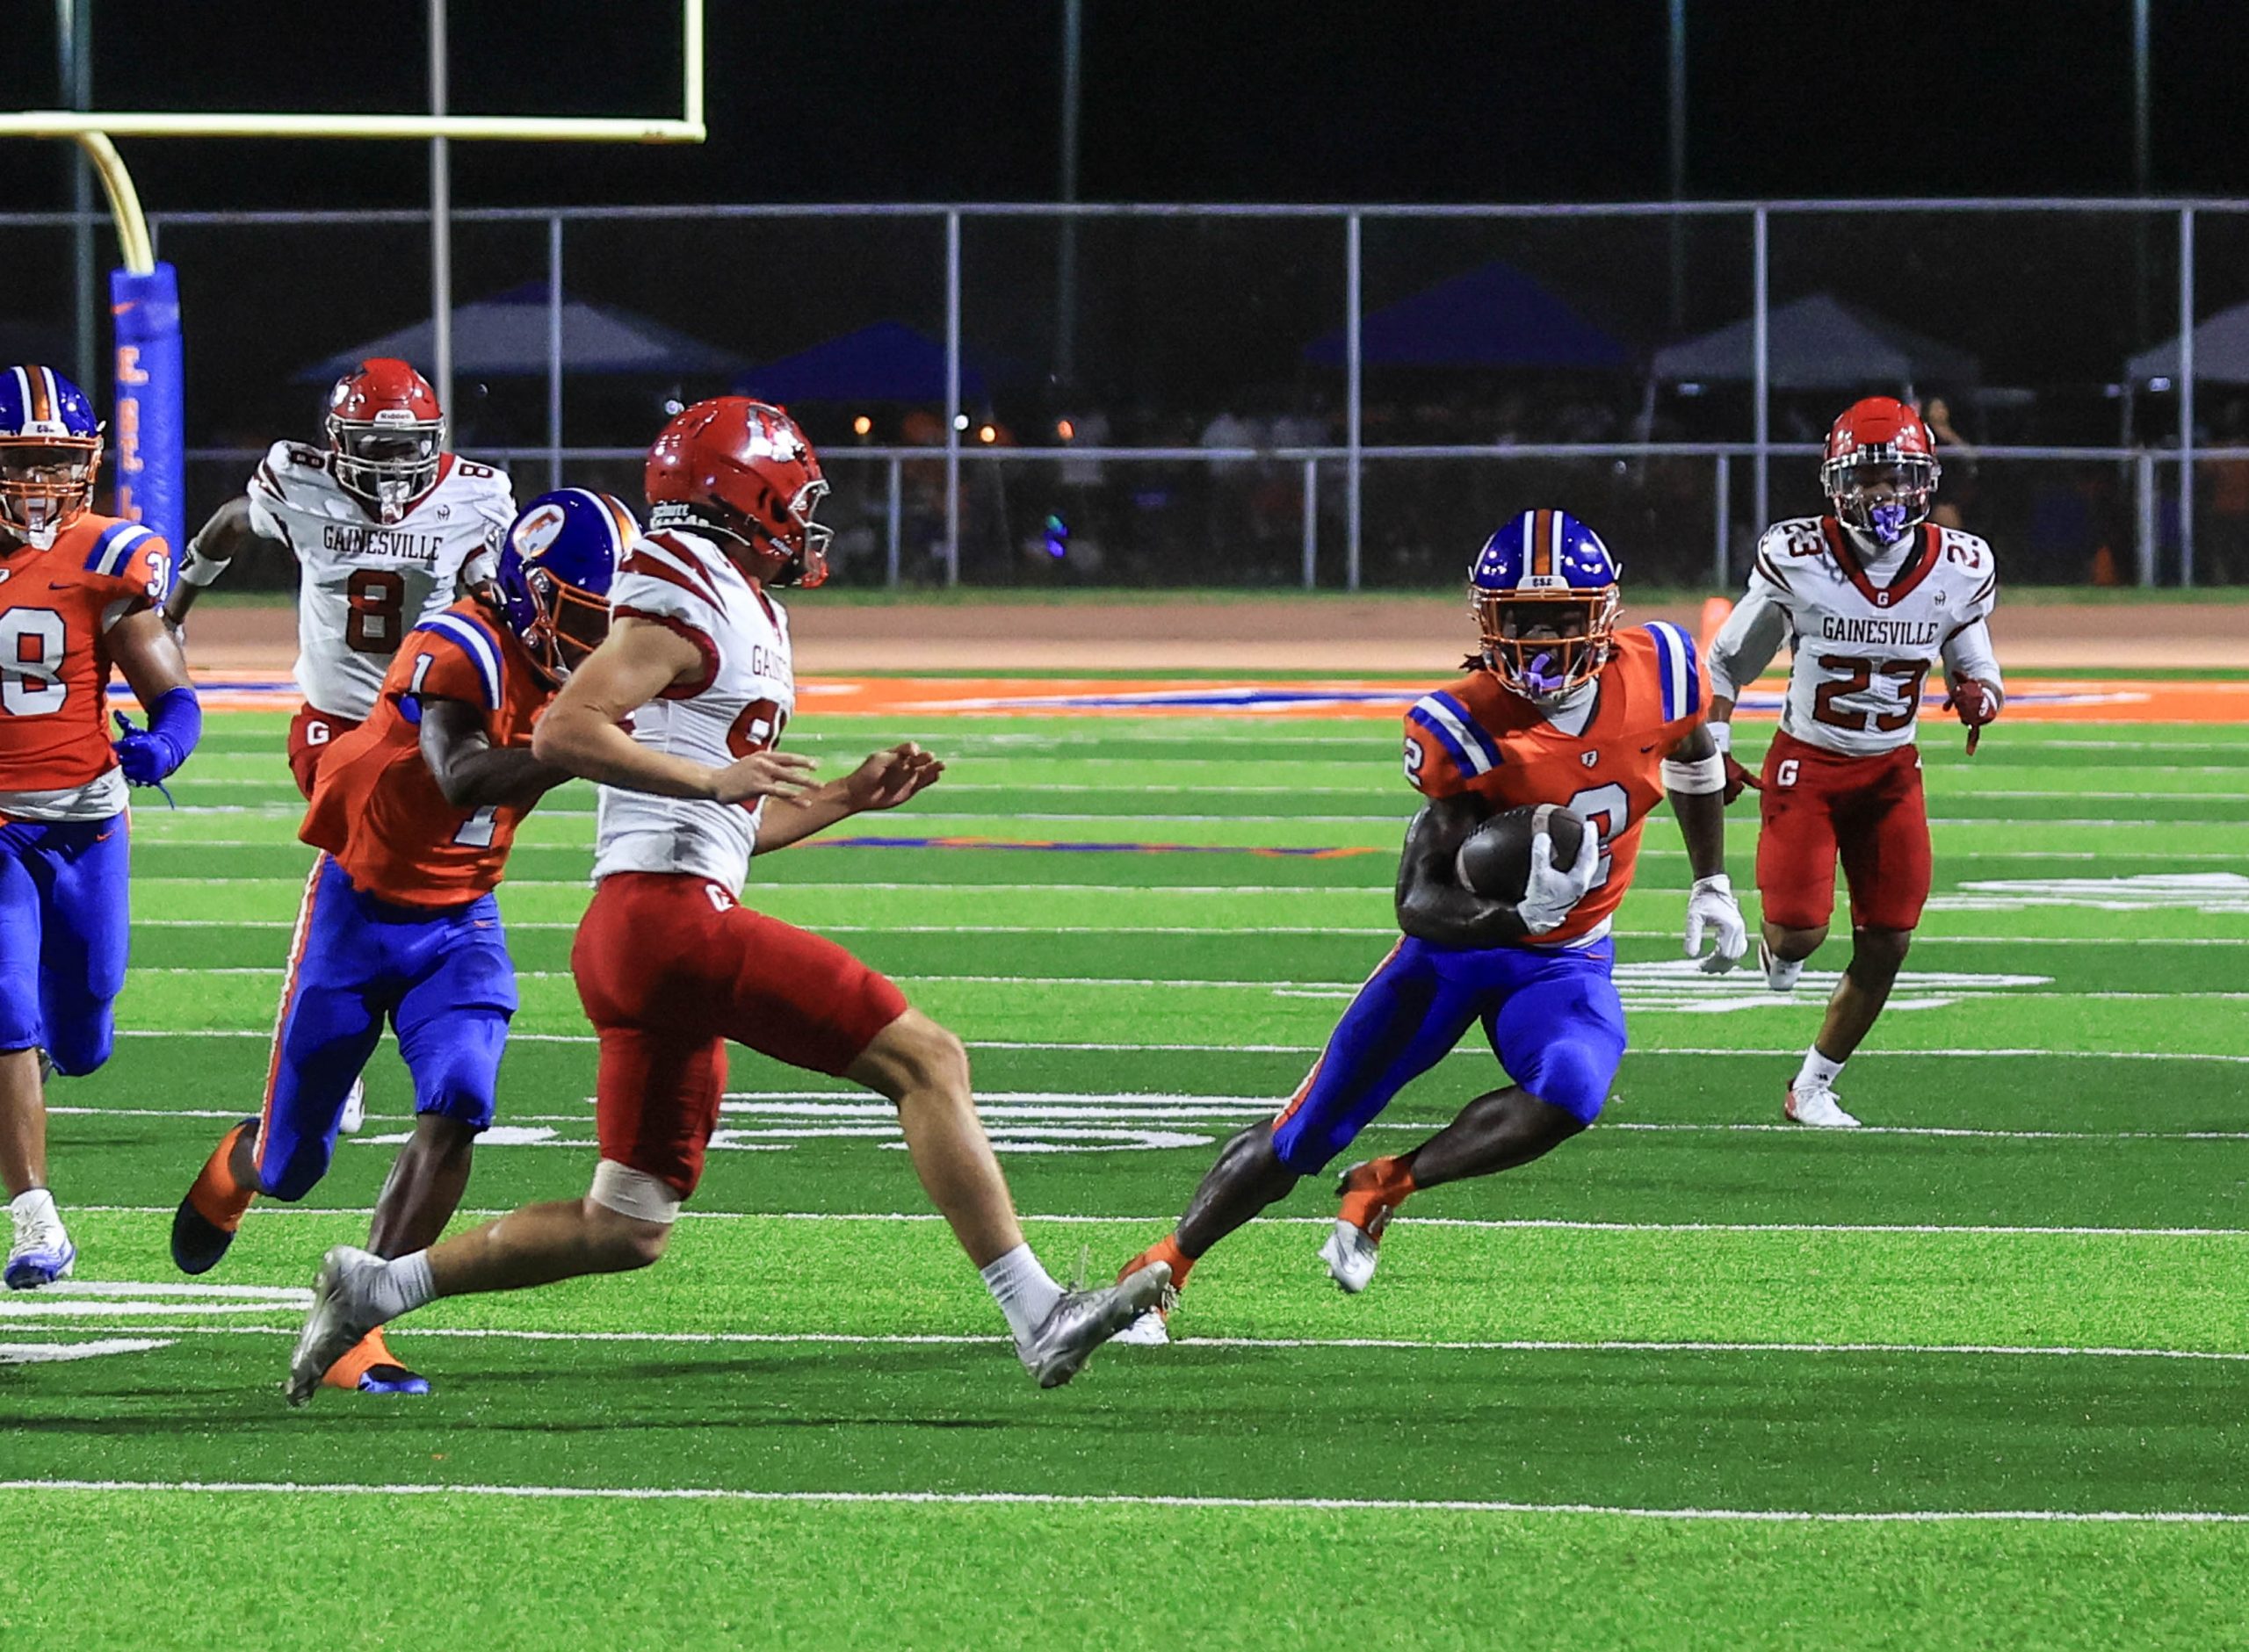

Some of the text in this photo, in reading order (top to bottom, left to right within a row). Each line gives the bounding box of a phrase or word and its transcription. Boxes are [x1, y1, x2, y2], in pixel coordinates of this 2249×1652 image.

[290, 451, 325, 469] 8
[459, 463, 493, 479] 8
[323, 525, 444, 559] GAINESVILLE
[346, 568, 405, 654] 8
[1877, 592, 1889, 605] G
[1822, 617, 1939, 646] GAINESVILLE
[410, 653, 434, 693] 1
[1813, 653, 1931, 732] 23
[307, 720, 329, 746] G
[1404, 736, 1423, 787] 2
[1587, 753, 1595, 764] F
[1777, 760, 1799, 786] G
